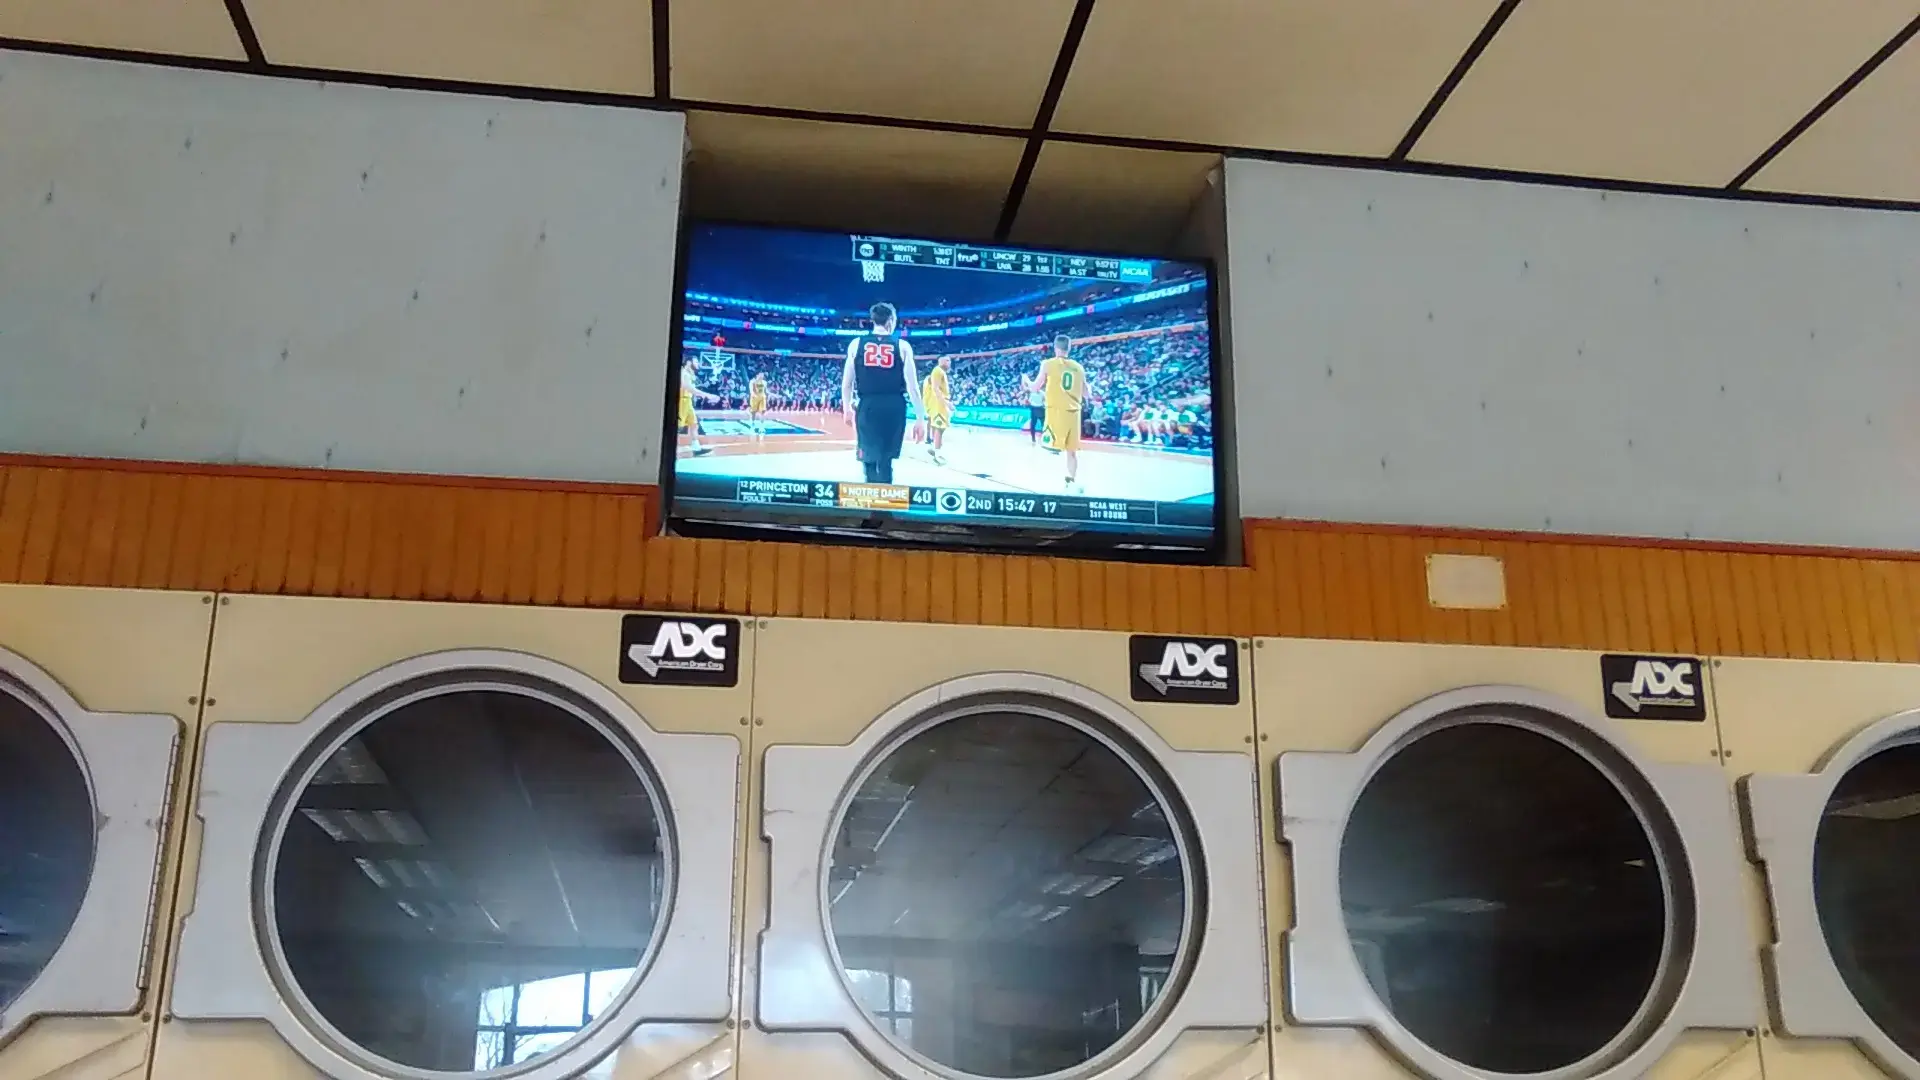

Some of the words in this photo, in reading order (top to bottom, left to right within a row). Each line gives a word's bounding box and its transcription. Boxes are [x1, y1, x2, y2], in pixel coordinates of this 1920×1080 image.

[893, 254, 914, 263] BUTL
[935, 257, 950, 265] TNT
[1022, 254, 1032, 262] 29
[1070, 258, 1086, 266] NEV
[864, 342, 894, 368] 25
[1062, 371, 1073, 391] 0
[749, 481, 809, 494] PRINCETON
[814, 483, 834, 499] 34
[848, 487, 879, 498] NOTRE
[880, 488, 908, 499] DAME
[815, 499, 834, 507] POSS
[912, 489, 932, 504] 40
[967, 496, 992, 511] 2ND
[998, 498, 1035, 513] 15:47
[1043, 501, 1057, 514] 17
[1089, 501, 1107, 510] NCAA
[1109, 502, 1127, 511] WEST
[1103, 510, 1128, 520] ROUND
[650, 621, 727, 660] ADC
[1156, 641, 1228, 679] ADC
[1629, 660, 1695, 696] ADC
